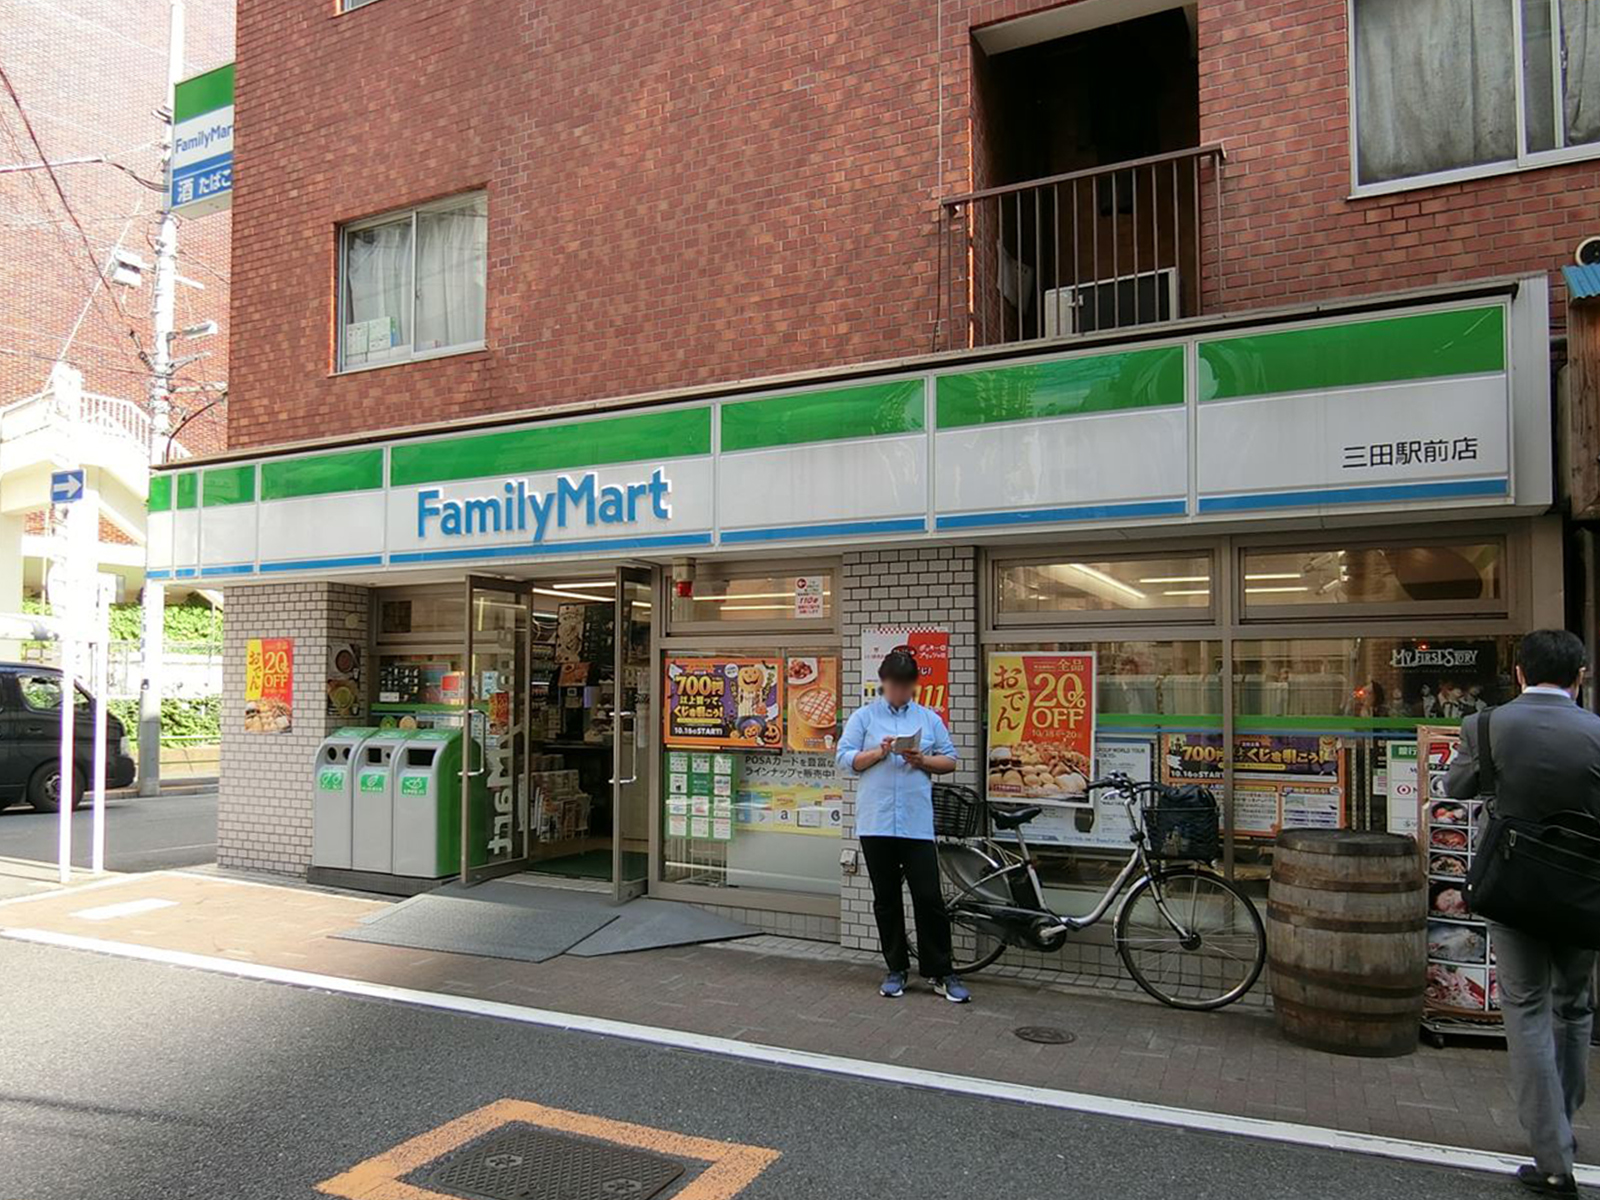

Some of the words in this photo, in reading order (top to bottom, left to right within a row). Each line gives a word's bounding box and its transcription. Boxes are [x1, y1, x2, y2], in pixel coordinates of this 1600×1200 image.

[175, 125, 233, 153] FamilyMar
[177, 178, 195, 203] 酒
[199, 169, 232, 195] たばこ
[1342, 437, 1478, 468] 三田駅前店
[418, 467, 671, 543] FamilyMart
[264, 674, 288, 688] OFF
[674, 675, 725, 696] 700円
[1033, 672, 1087, 708] 20%
[993, 665, 1026, 732] おでん
[1032, 707, 1085, 729] OFF
[745, 756, 835, 768] POSAカードを豊富な
[745, 767, 836, 780] ラインナップで販売中!
